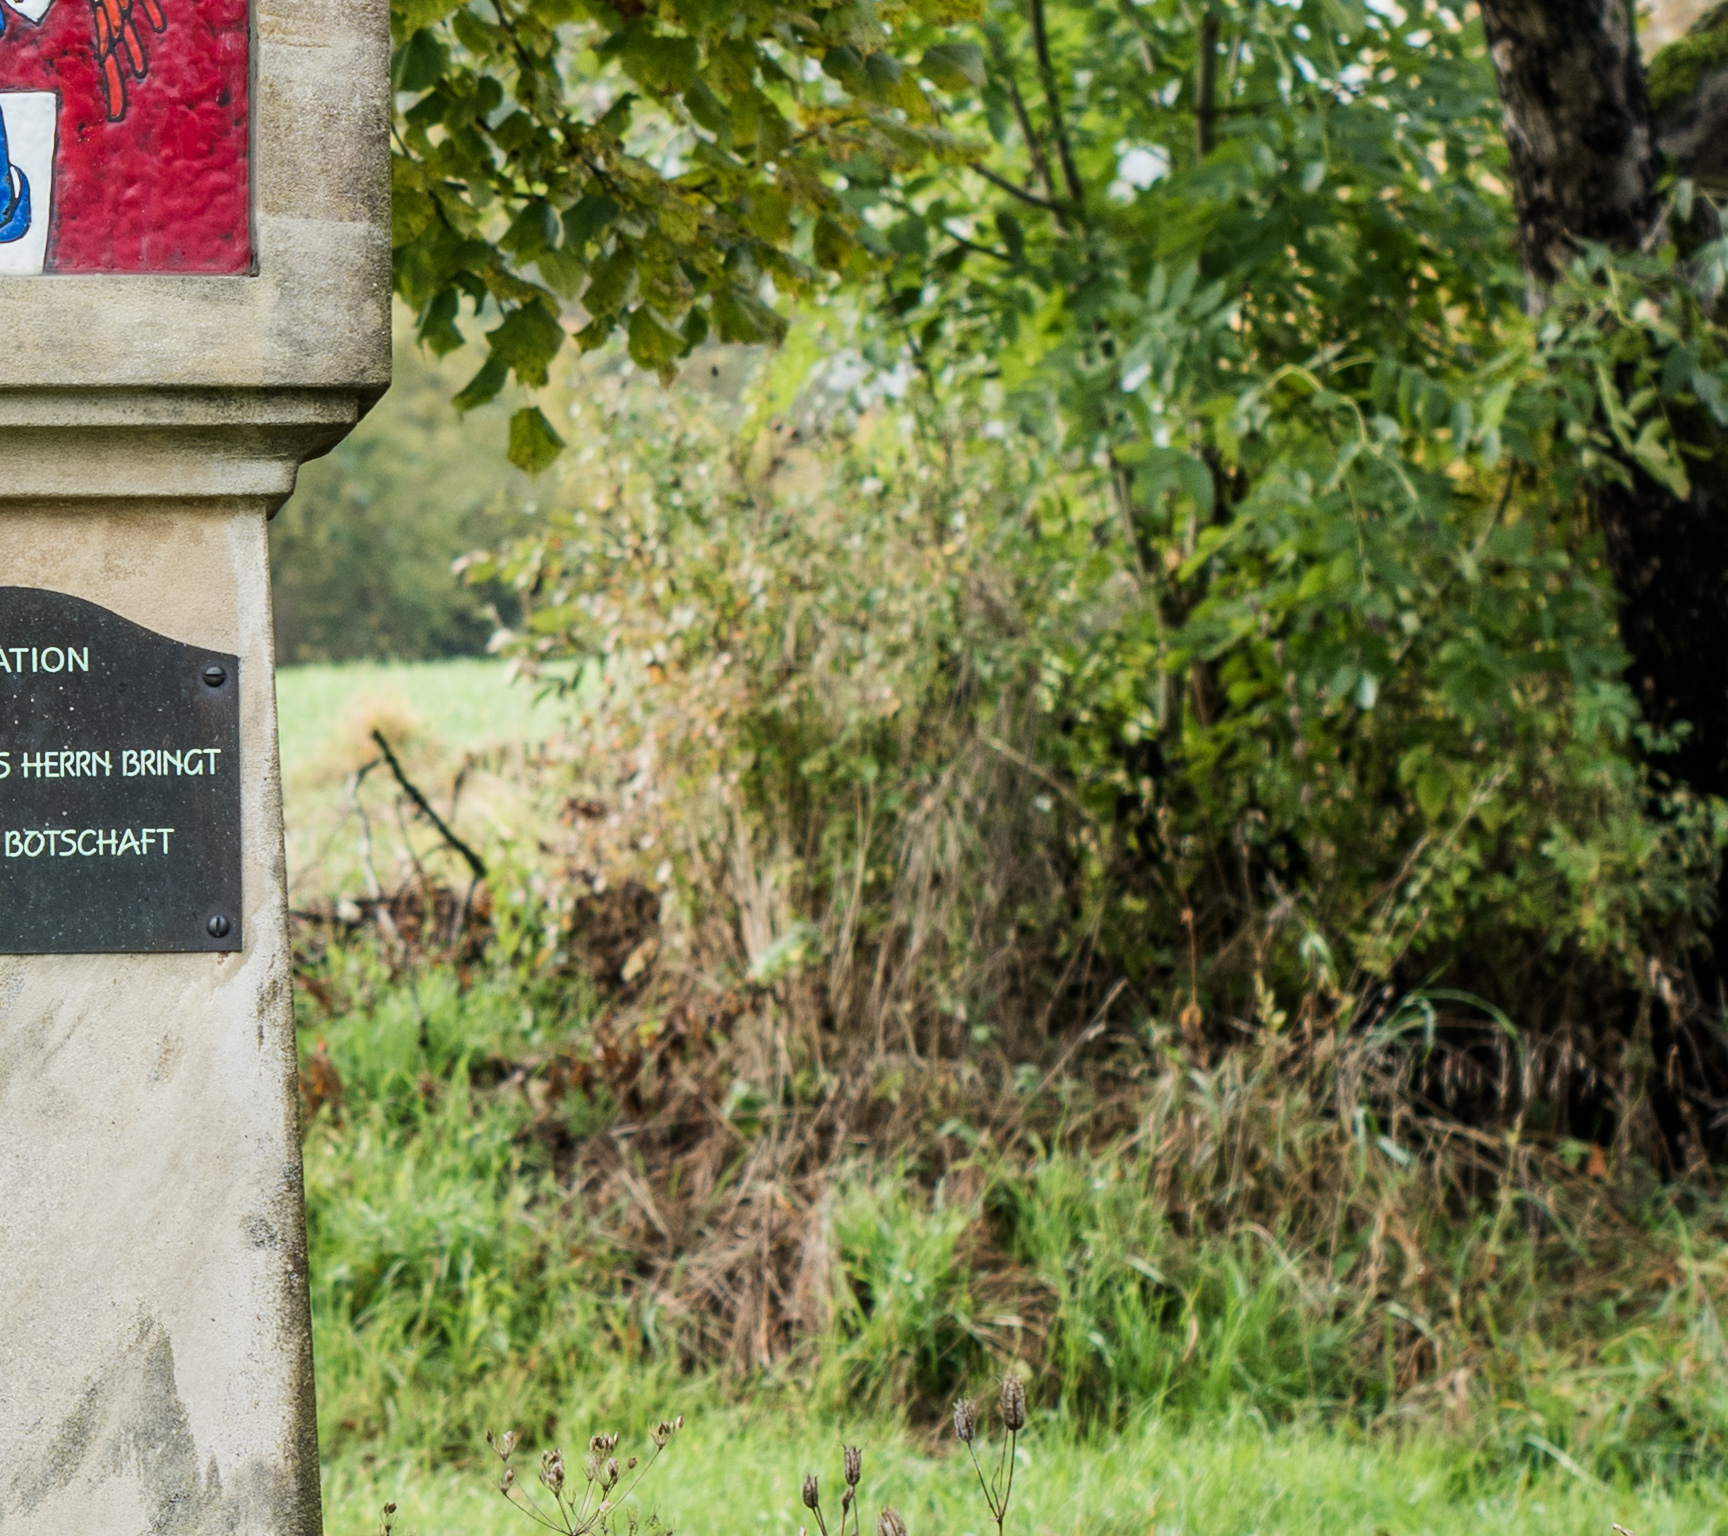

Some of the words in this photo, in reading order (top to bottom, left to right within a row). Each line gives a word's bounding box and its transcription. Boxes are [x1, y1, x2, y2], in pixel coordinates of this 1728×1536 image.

[20, 750, 114, 779] HERRN
[122, 748, 222, 777] BRINGT
[4, 827, 175, 858] BOTSCHAFT
